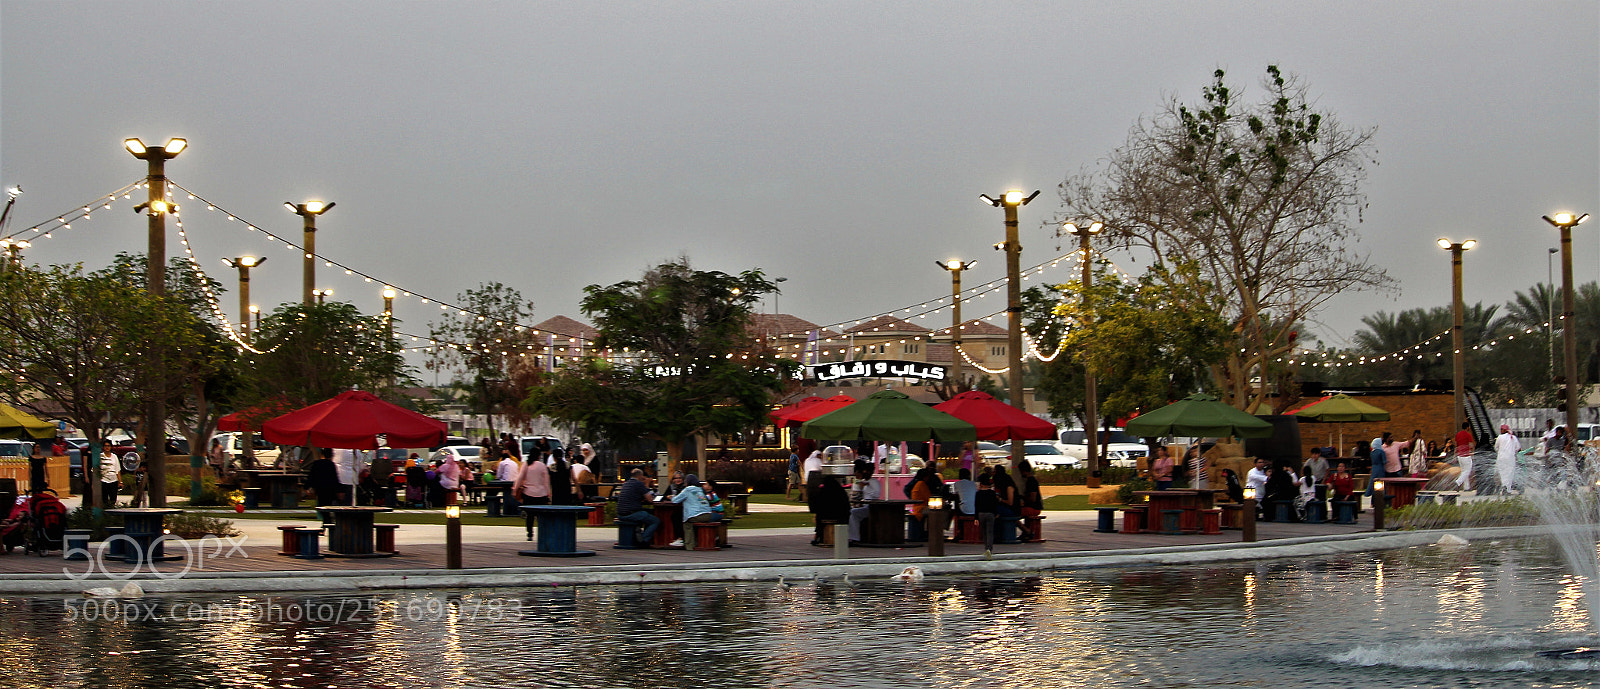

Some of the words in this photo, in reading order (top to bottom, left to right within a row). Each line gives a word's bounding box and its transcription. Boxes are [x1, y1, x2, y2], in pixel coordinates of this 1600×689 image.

[817, 361, 872, 381] رقاق
[874, 362, 888, 374] و
[889, 363, 945, 380] كباب
